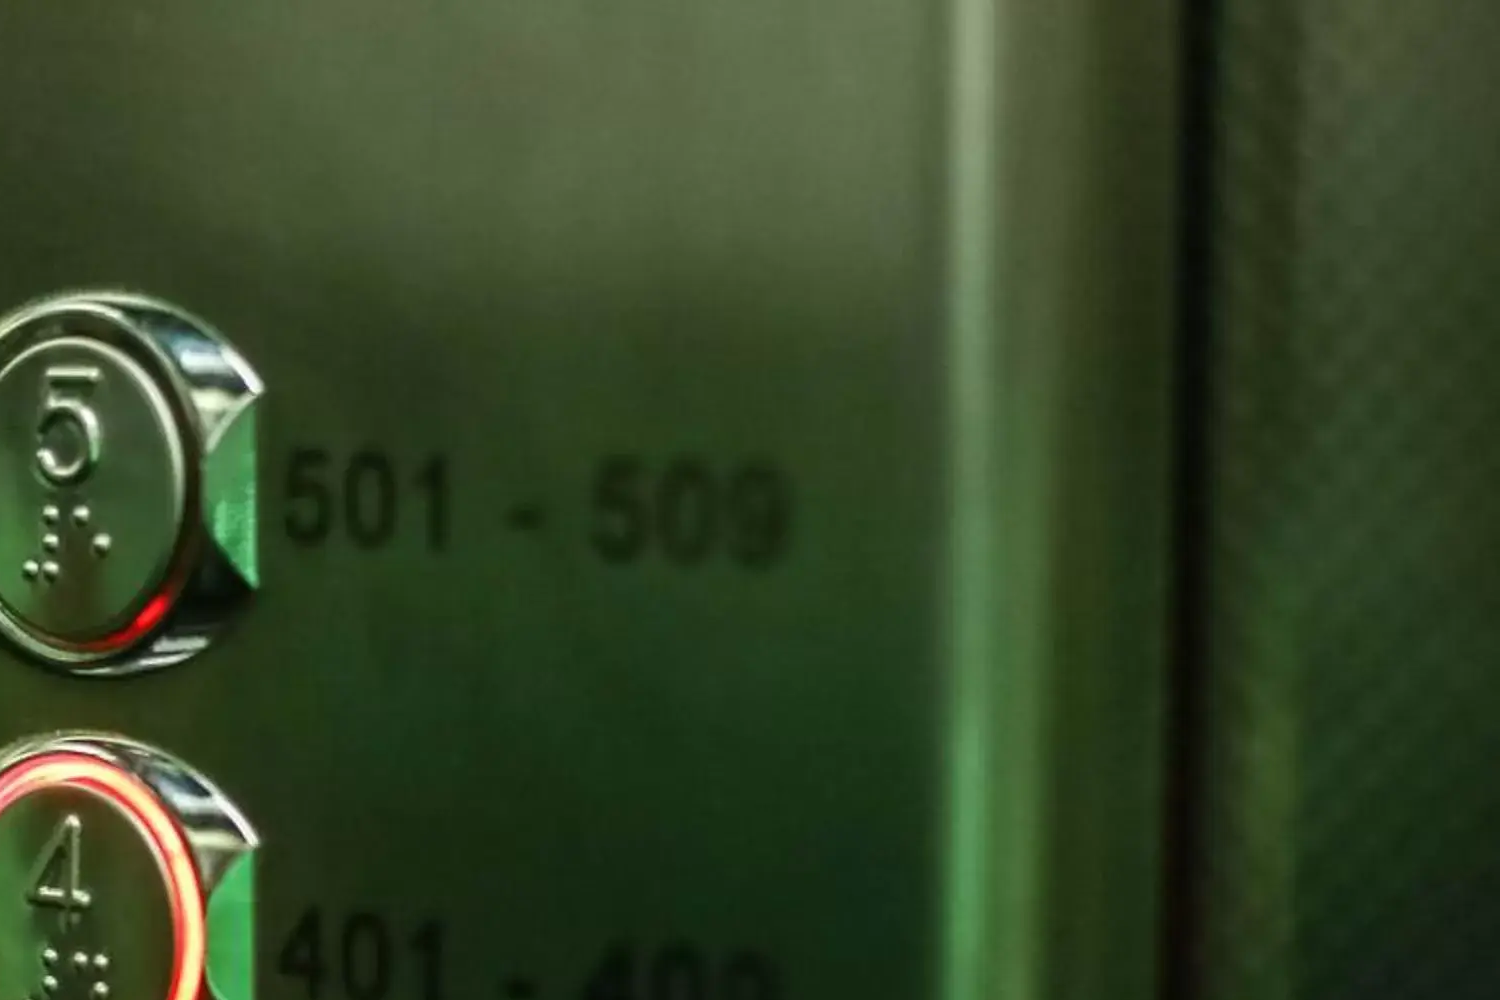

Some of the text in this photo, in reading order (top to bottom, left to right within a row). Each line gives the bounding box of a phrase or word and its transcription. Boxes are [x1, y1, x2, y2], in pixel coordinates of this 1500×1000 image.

[36, 366, 101, 487] 5
[283, 447, 794, 570] 501 - 509
[26, 813, 92, 934] 4
[501, 974, 540, 1000] -
